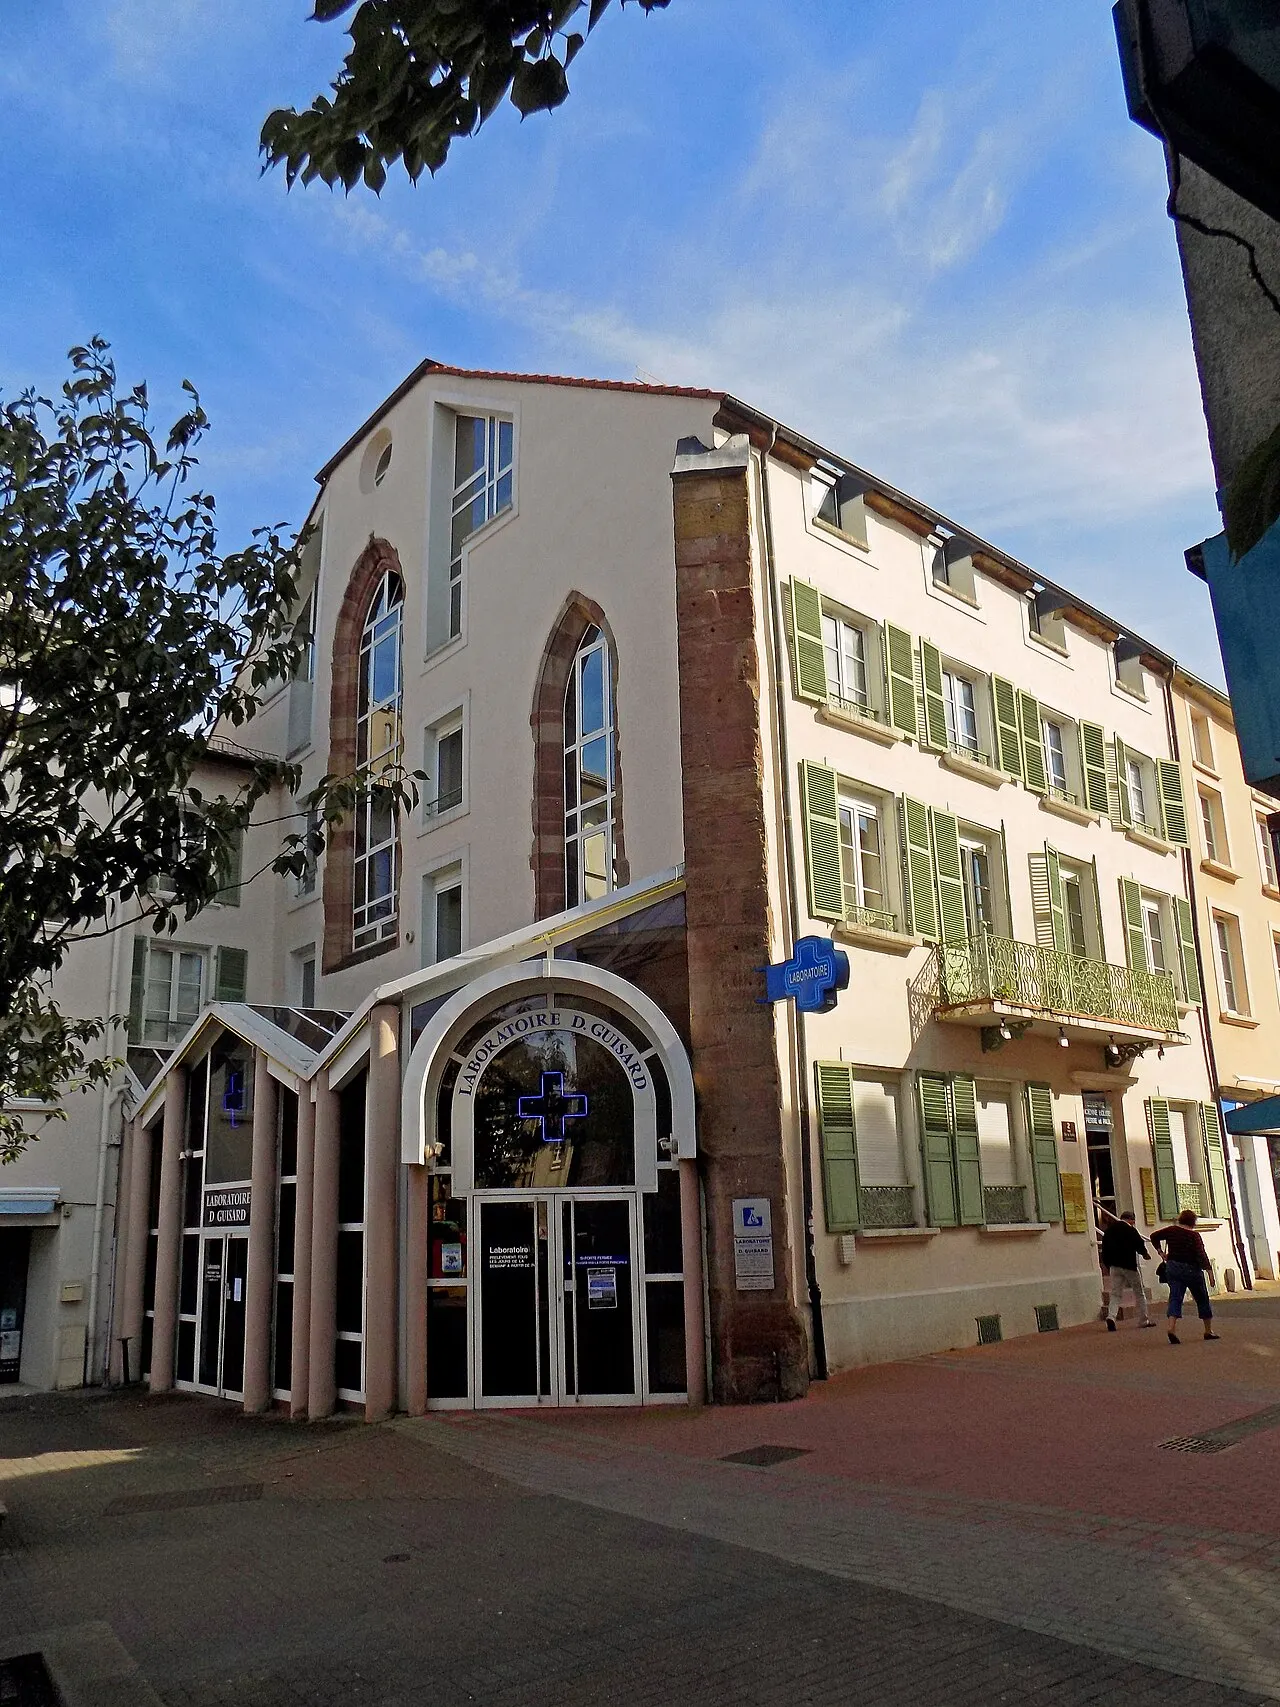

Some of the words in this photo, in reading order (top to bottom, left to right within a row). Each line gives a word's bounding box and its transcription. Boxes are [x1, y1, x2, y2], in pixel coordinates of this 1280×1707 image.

[789, 964, 828, 984] LABORATOIRE
[459, 1013, 560, 1096] LABORATOIRE
[591, 1024, 647, 1090] GUISARD
[206, 1192, 251, 1207] LABORATOIRE
[217, 1209, 246, 1222] GUISARD
